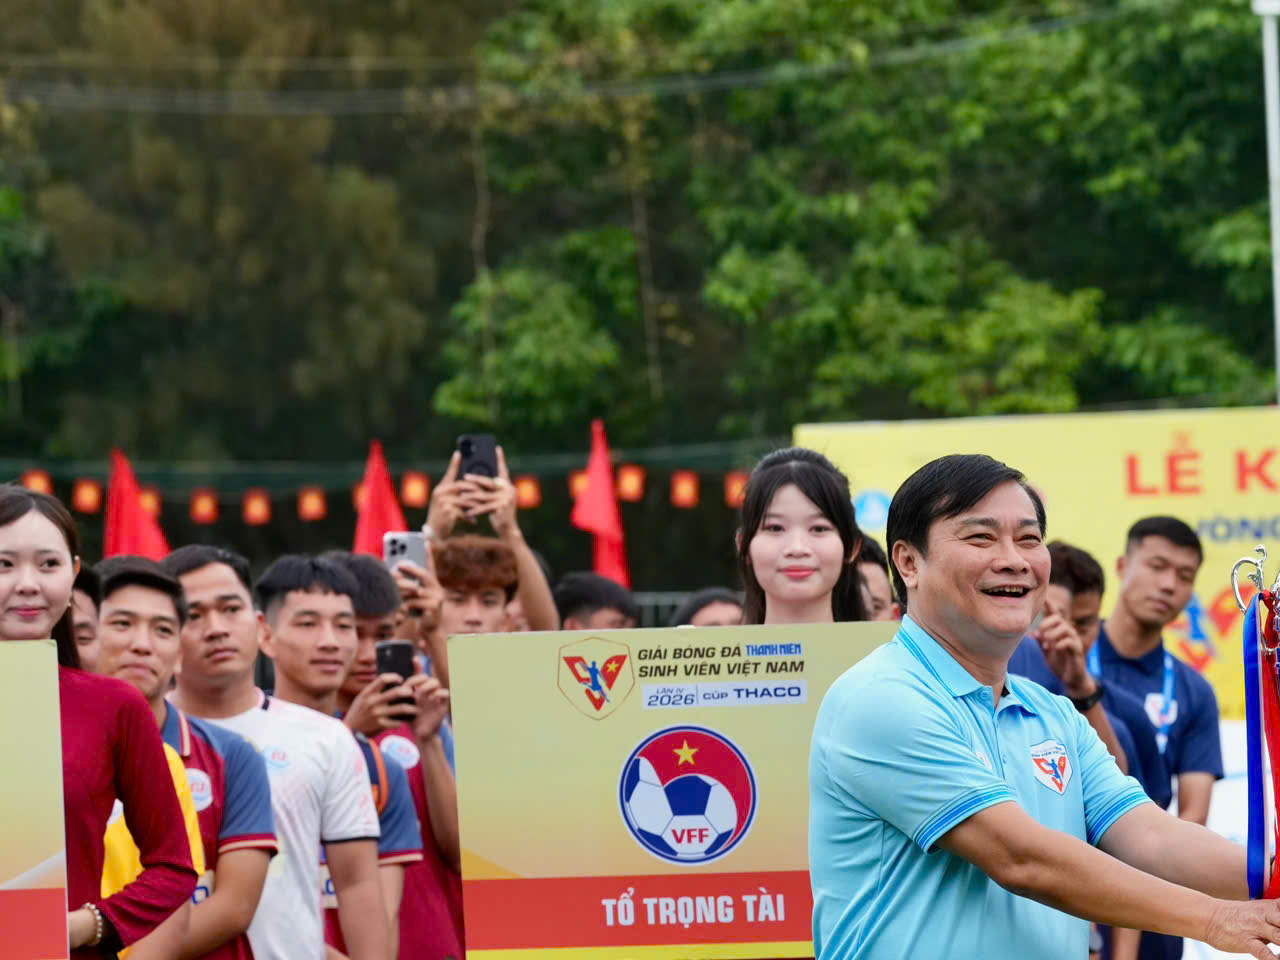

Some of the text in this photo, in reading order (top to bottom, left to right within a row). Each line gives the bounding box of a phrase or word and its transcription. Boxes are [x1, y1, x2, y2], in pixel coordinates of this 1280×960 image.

[637, 645, 668, 661] GIẢI
[672, 644, 716, 660] BÓNG
[720, 644, 742, 658] ĐÁ
[638, 659, 805, 678] SINH VIÊN VIỆT NAM
[647, 693, 695, 707] 2026
[702, 686, 802, 701] CÚP THACO
[671, 828, 710, 844] VFF
[601, 886, 785, 928] TỔ TRỌNG TÀI
